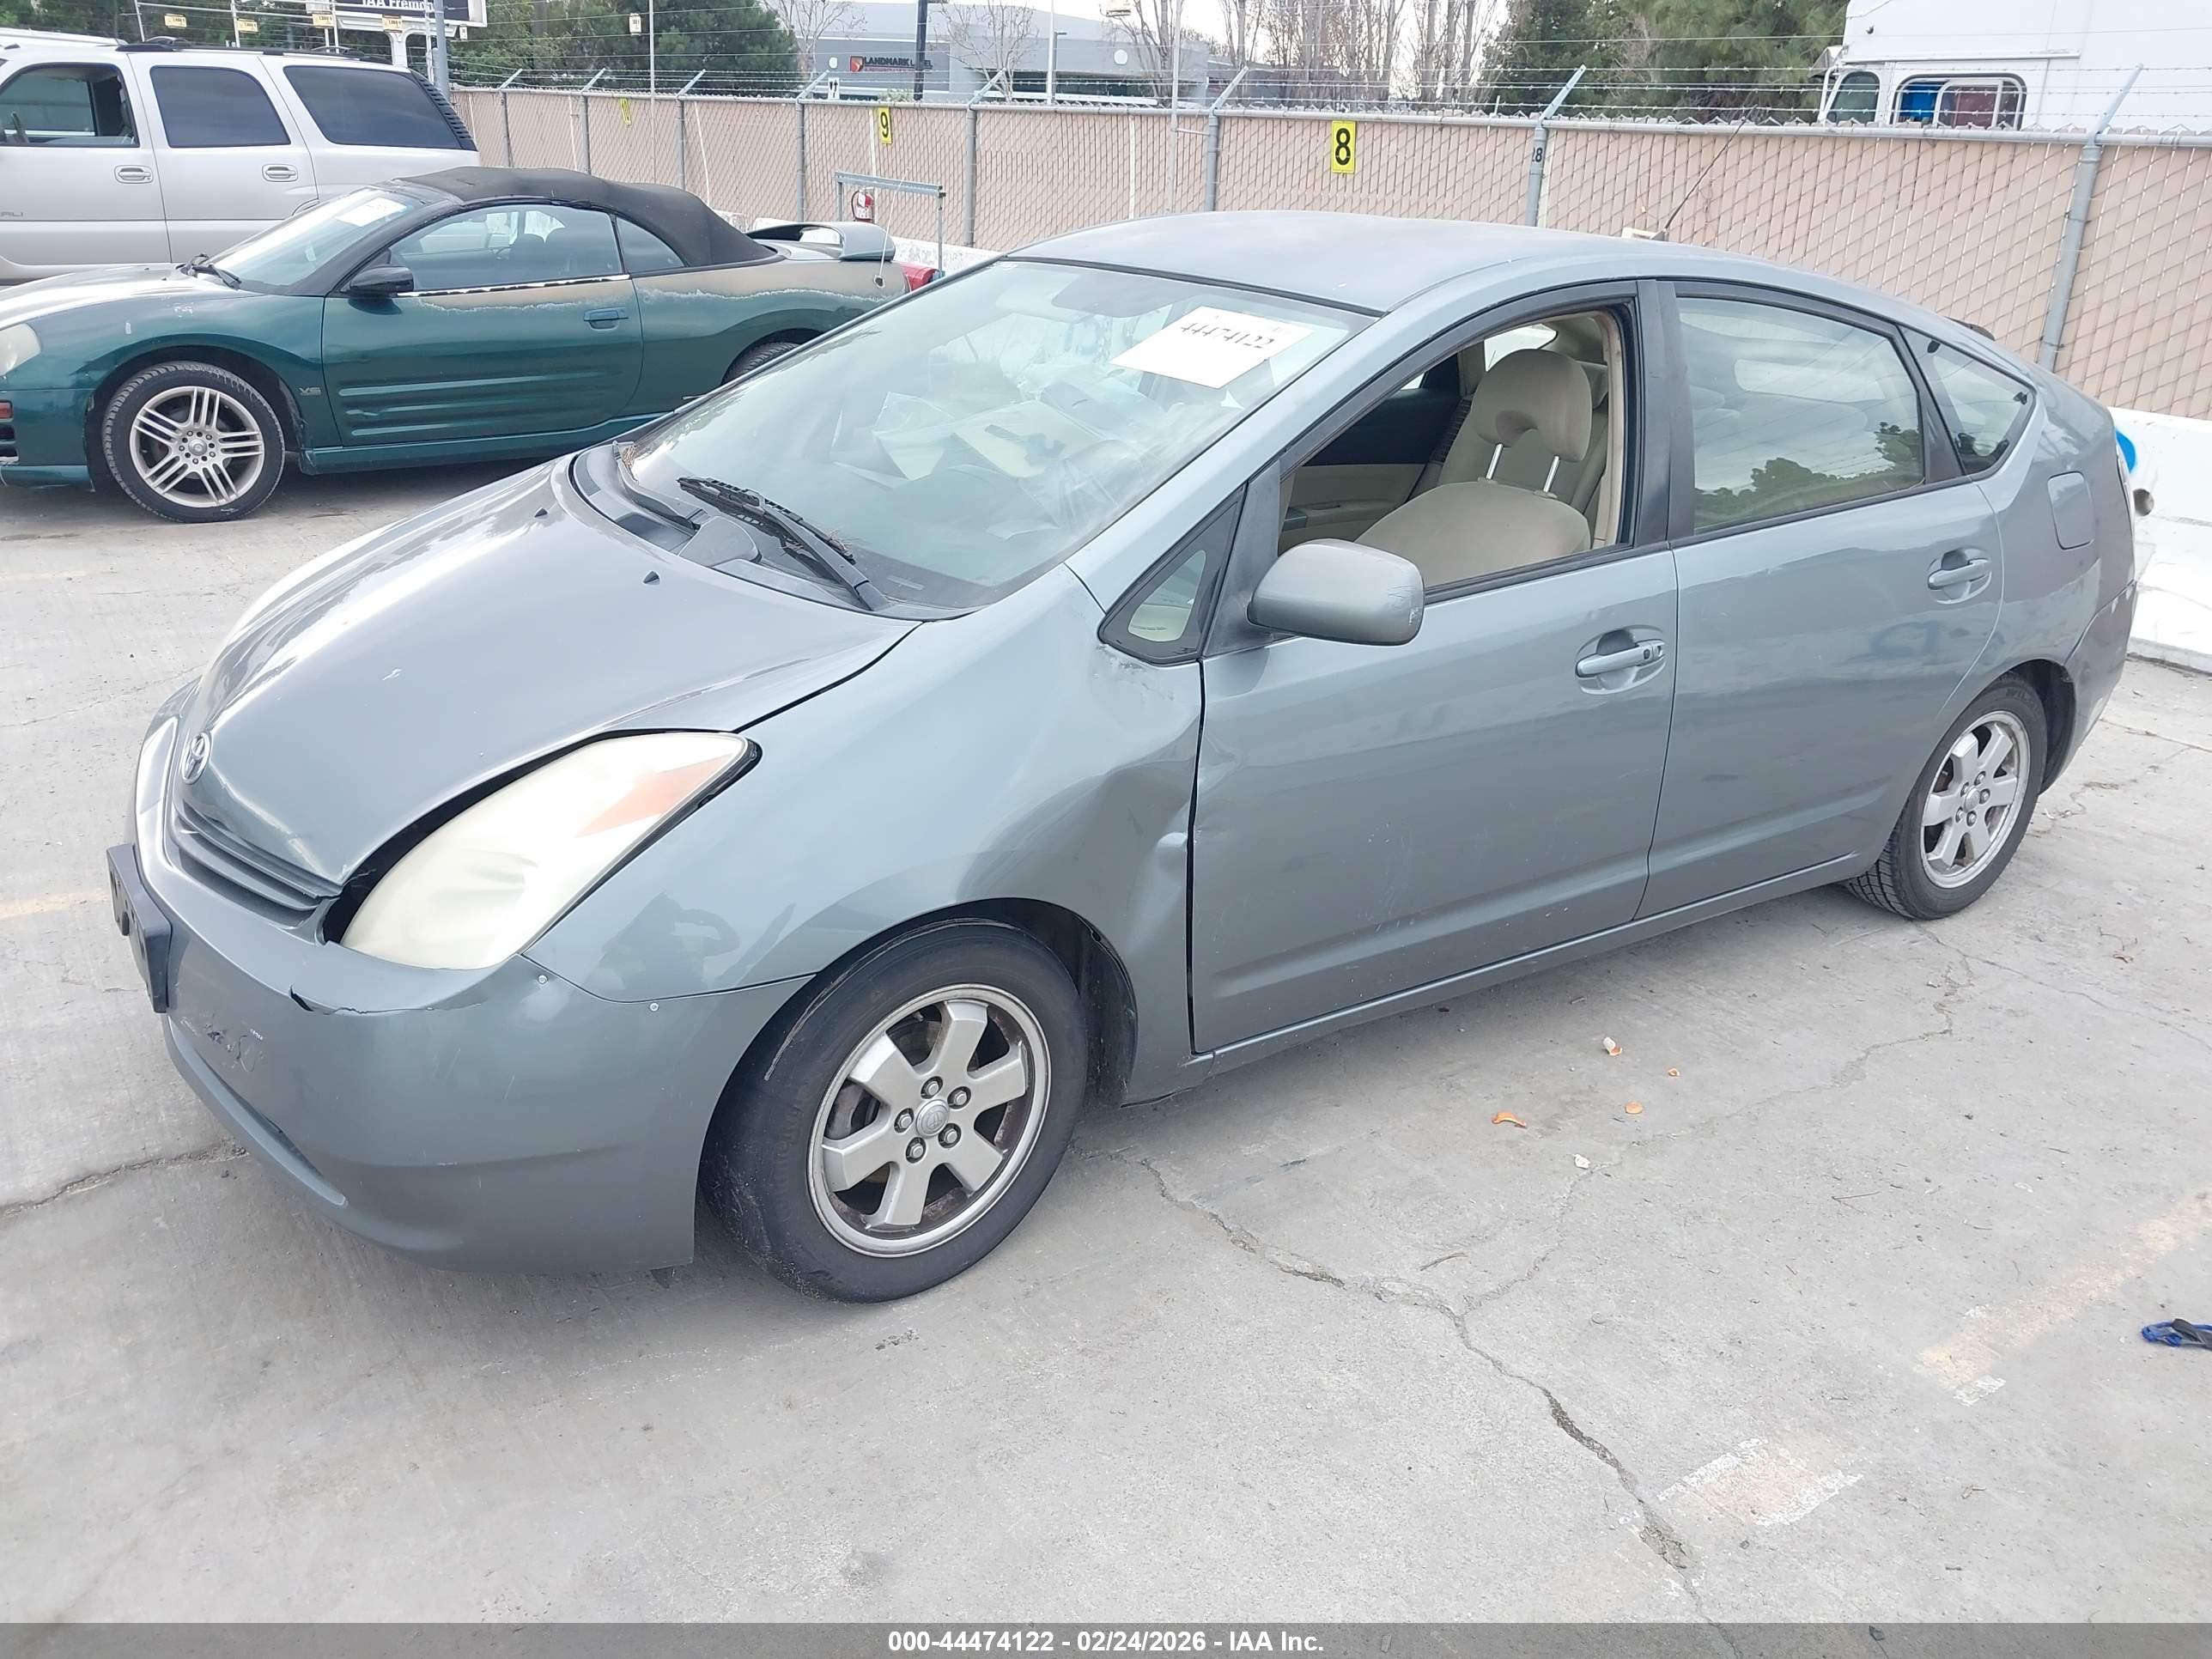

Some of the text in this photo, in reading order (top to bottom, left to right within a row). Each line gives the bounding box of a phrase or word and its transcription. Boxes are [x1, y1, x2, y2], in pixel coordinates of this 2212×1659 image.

[864, 57, 933, 69] LANDMARK LEL
[880, 112, 889, 138] 9
[1335, 128, 1351, 166] 8
